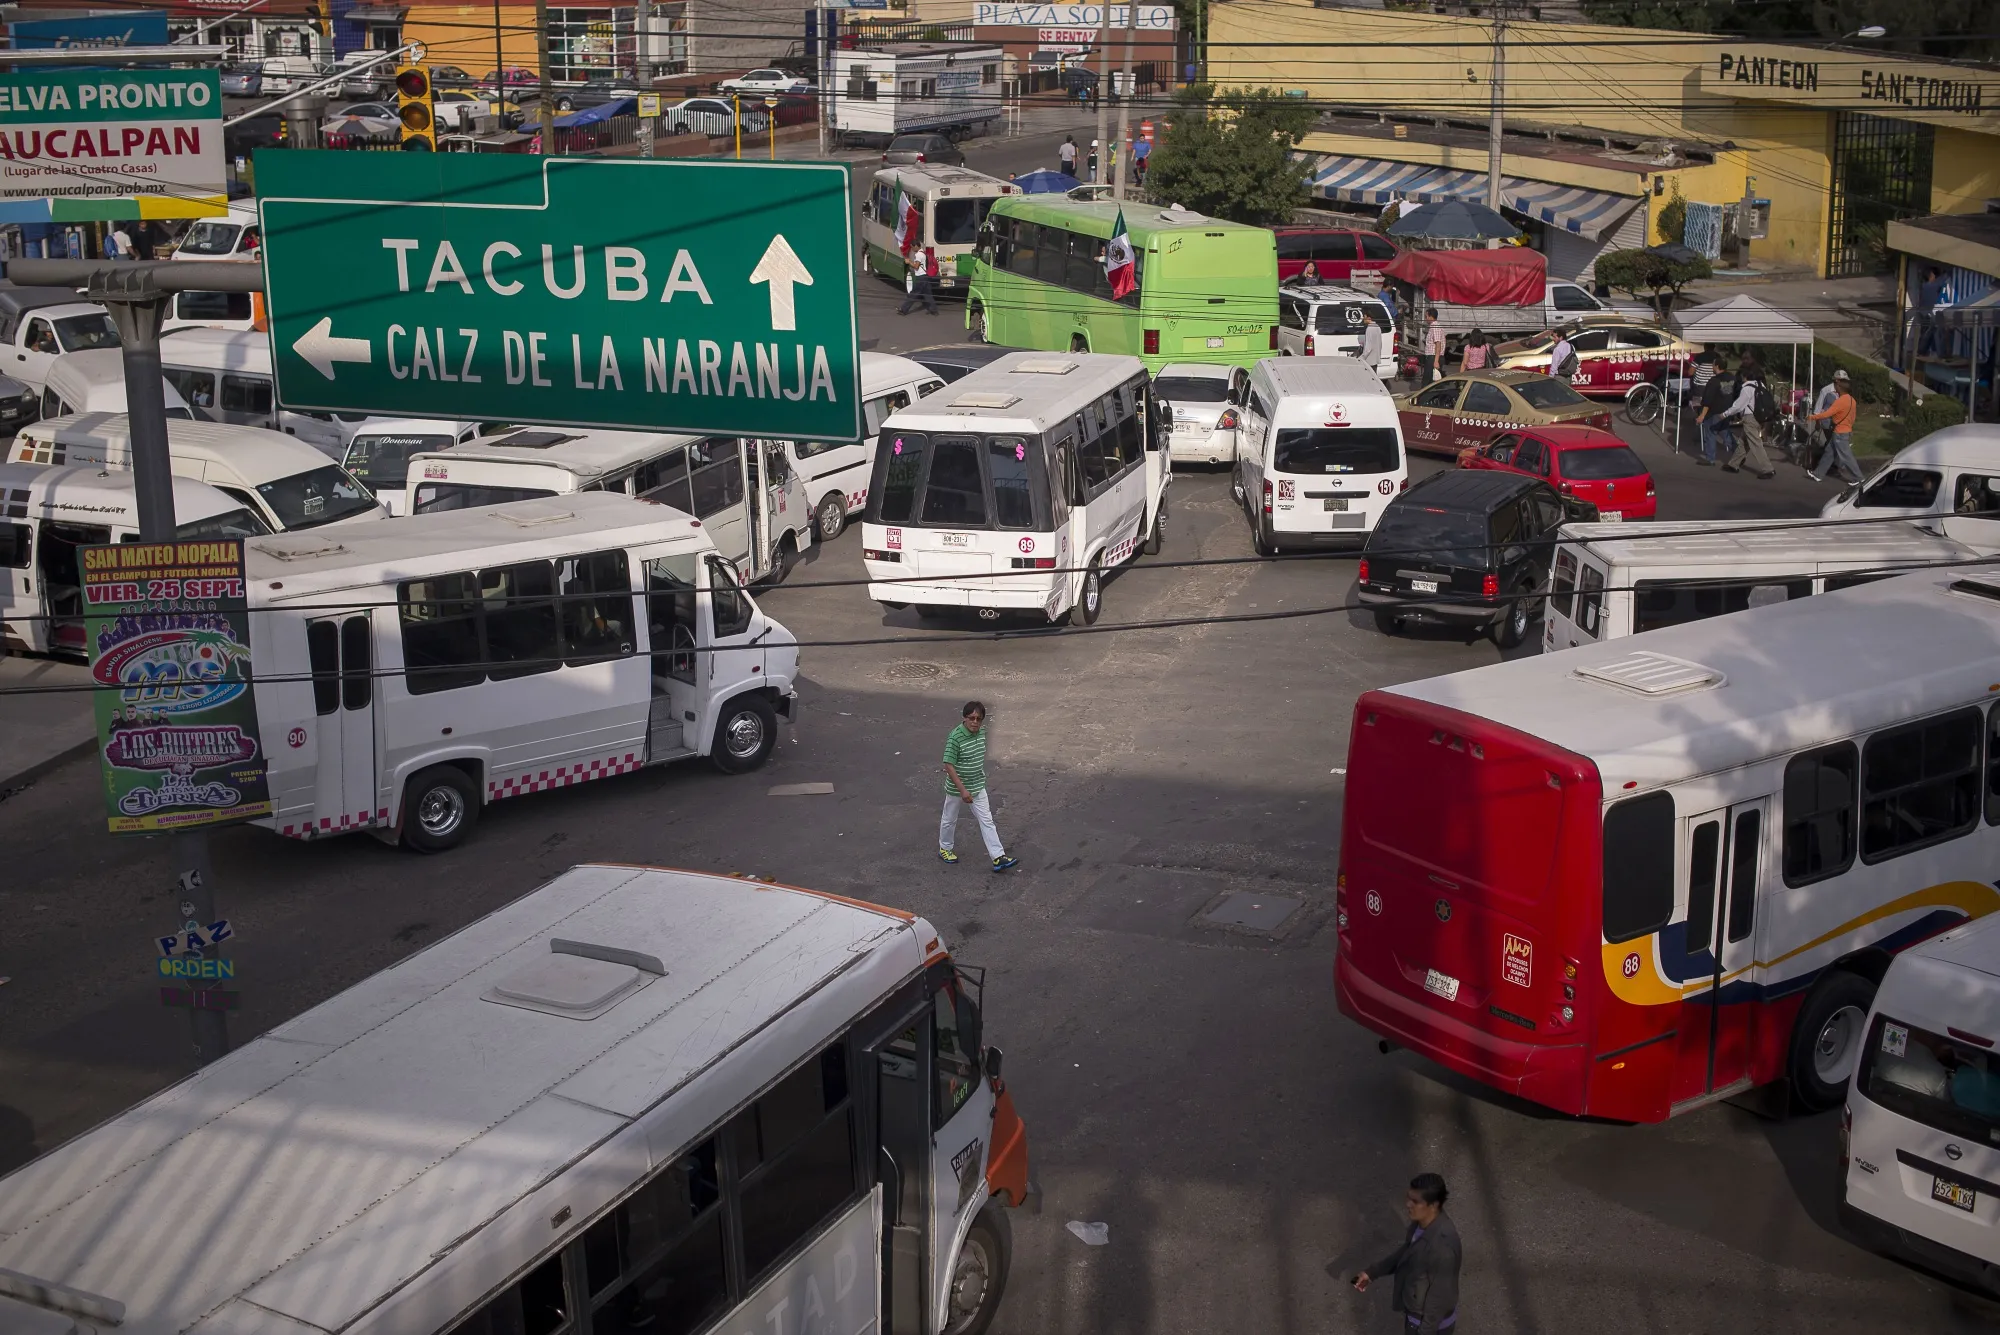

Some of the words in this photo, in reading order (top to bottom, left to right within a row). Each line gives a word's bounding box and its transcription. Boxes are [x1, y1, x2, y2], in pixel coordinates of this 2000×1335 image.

[978, 4, 1060, 24] PLAZA
[1068, 5, 1168, 28] SOELO
[1720, 53, 1818, 92] PANTEON
[1861, 69, 1982, 117] SANCTORUM
[78, 82, 211, 110] PRONTO
[4, 166, 41, 179] (Lugar
[44, 165, 58, 175] de
[61, 164, 77, 175] las
[80, 163, 118, 175] Cuatro
[121, 162, 157, 174] Casas)
[4, 181, 166, 199] www.naucalpan.gob.mx
[382, 237, 714, 305] TACUBA
[387, 323, 481, 383] CALZ
[502, 330, 552, 387] DE
[572, 333, 624, 391] LA
[643, 336, 837, 402] NARANJA
[1571, 374, 1592, 383] AXI
[380, 436, 423, 445] Donovan
[1379, 482, 1393, 494] 151
[1020, 539, 1034, 552] 89
[85, 548, 118, 570] SAN
[120, 545, 174, 568] MATEO
[177, 543, 239, 564] NOPALA
[86, 573, 99, 583] EN
[101, 572, 111, 582] EL
[112, 570, 148, 581] CAMPO
[150, 569, 162, 579] DE
[164, 568, 199, 579] FUTBOL
[201, 567, 238, 577] NOPALA
[84, 583, 145, 605] VIER.
[147, 579, 181, 600] 25
[184, 578, 245, 599] SEPT.
[105, 653, 122, 678] BANDA
[177, 702, 203, 711] SERGIO
[119, 734, 157, 760] LOS
[160, 730, 241, 756] BUITRES
[289, 732, 305, 745] 90
[163, 775, 193, 787] LA
[230, 769, 263, 778] PREVENTA
[1368, 893, 1380, 912] 88
[159, 920, 232, 956] PAZ
[159, 958, 235, 978] ORDEN
[1507, 955, 1529, 967] AUTOBUSES
[1511, 962, 1529, 974] MELCHOR
[1625, 955, 1639, 975] 88
[1509, 968, 1526, 978] OCAMPO
